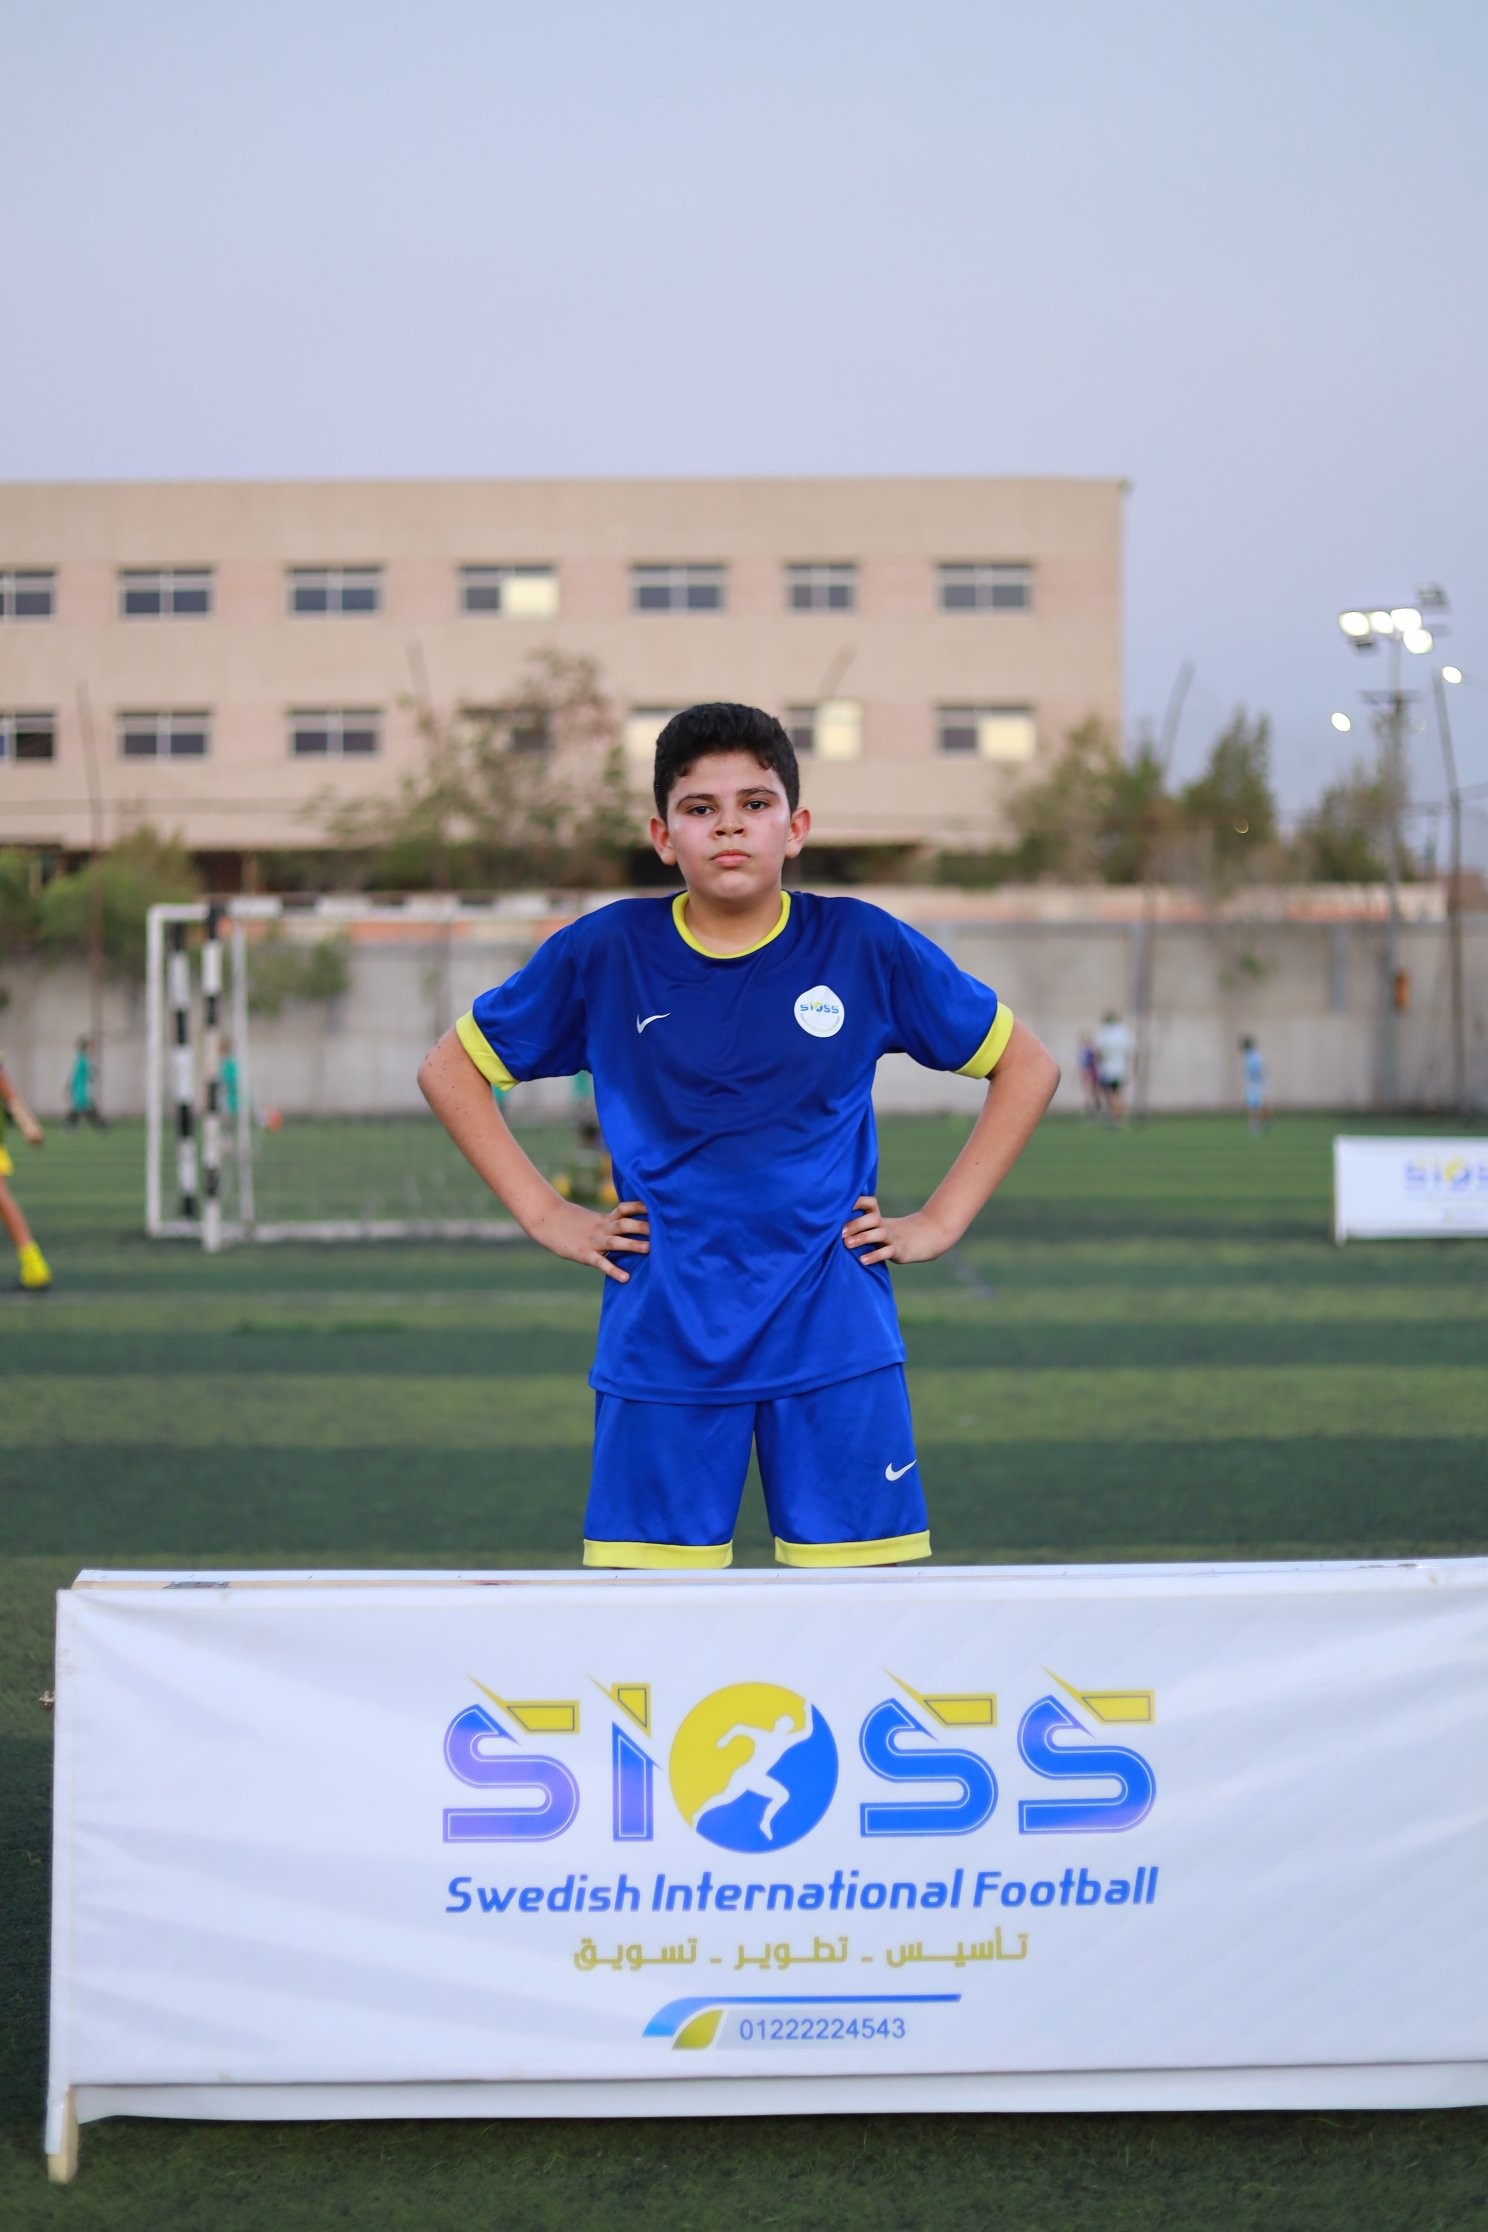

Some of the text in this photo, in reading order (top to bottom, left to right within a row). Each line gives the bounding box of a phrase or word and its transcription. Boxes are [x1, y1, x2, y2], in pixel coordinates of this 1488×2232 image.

[445, 1866, 1159, 1914] Swedish International Football
[573, 1935, 698, 1972] تسويق
[733, 1935, 848, 1970] تطوير
[886, 1925, 1028, 1968] تأسيس
[738, 2017, 907, 2042] 01222224543
